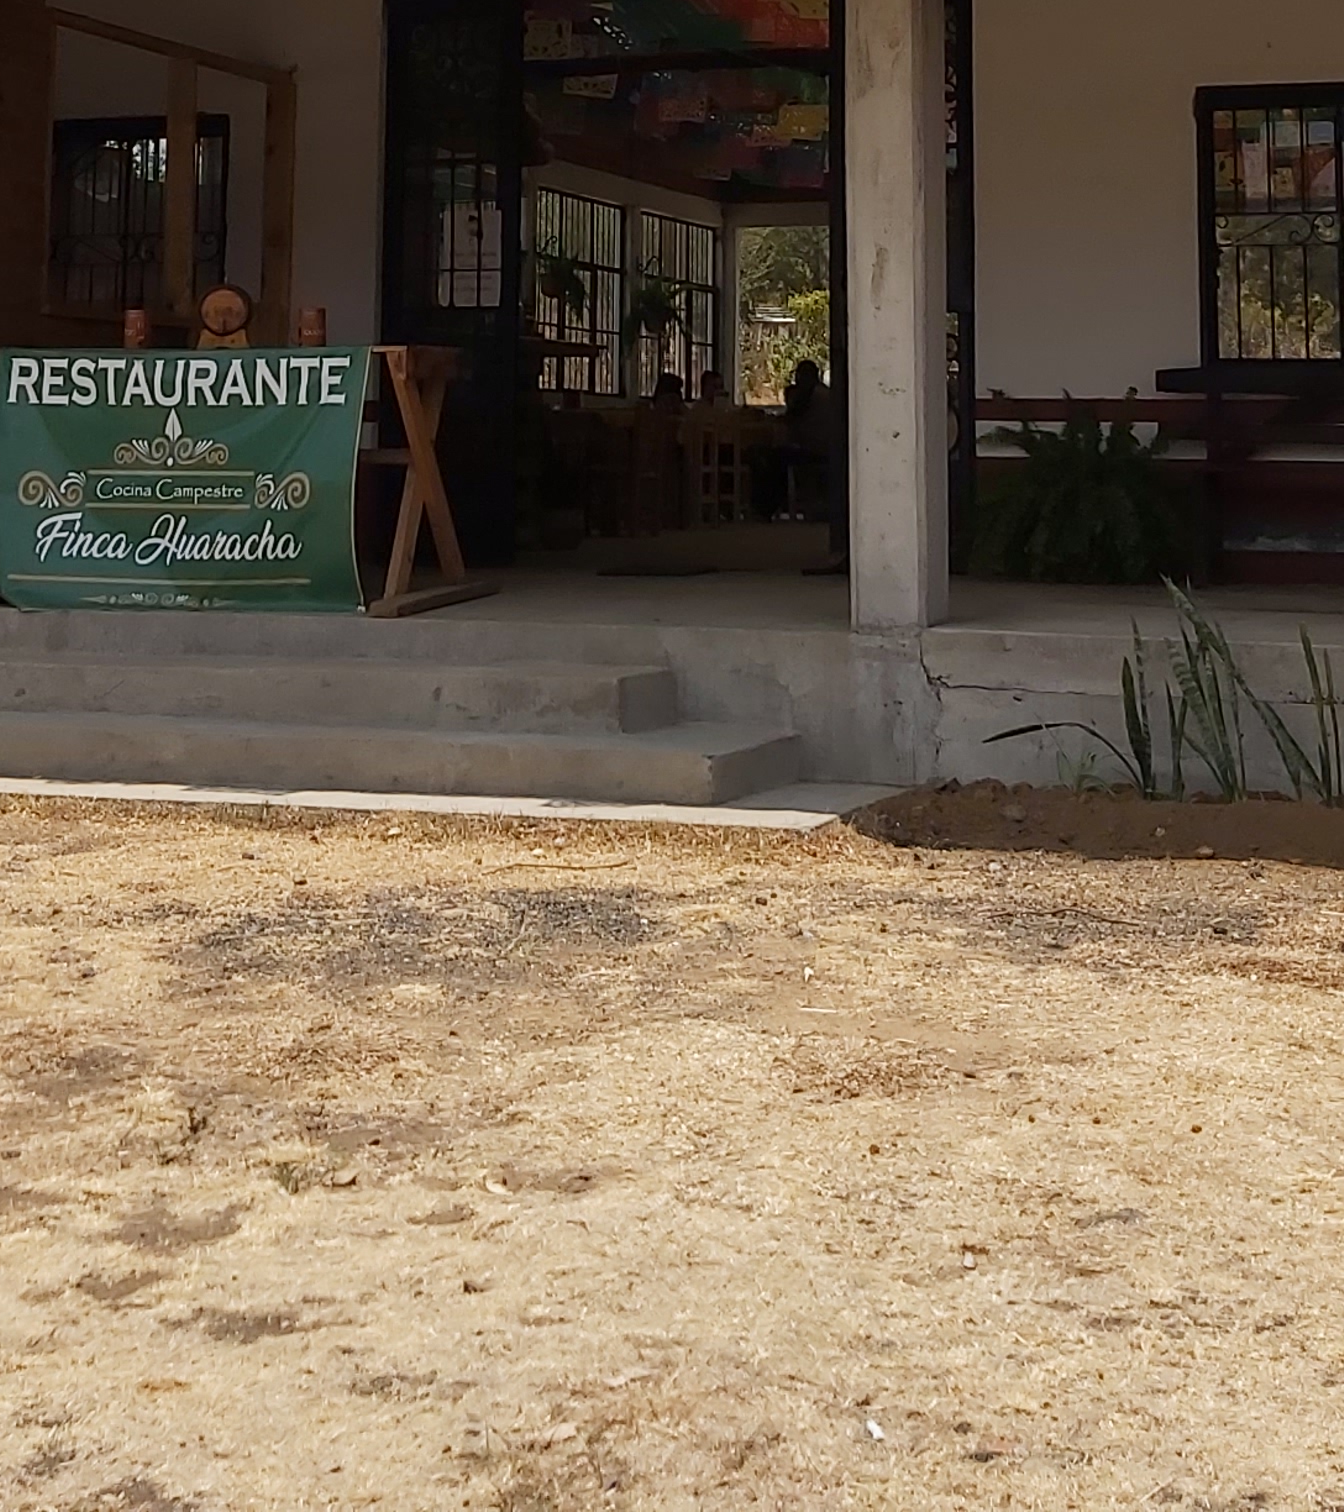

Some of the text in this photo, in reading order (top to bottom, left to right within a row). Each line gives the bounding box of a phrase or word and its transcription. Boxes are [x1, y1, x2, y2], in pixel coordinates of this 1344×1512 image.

[6, 356, 351, 407] RESTAURANTE
[96, 477, 244, 505] Cocina Campestre
[35, 511, 303, 567] Finca Huaracha
